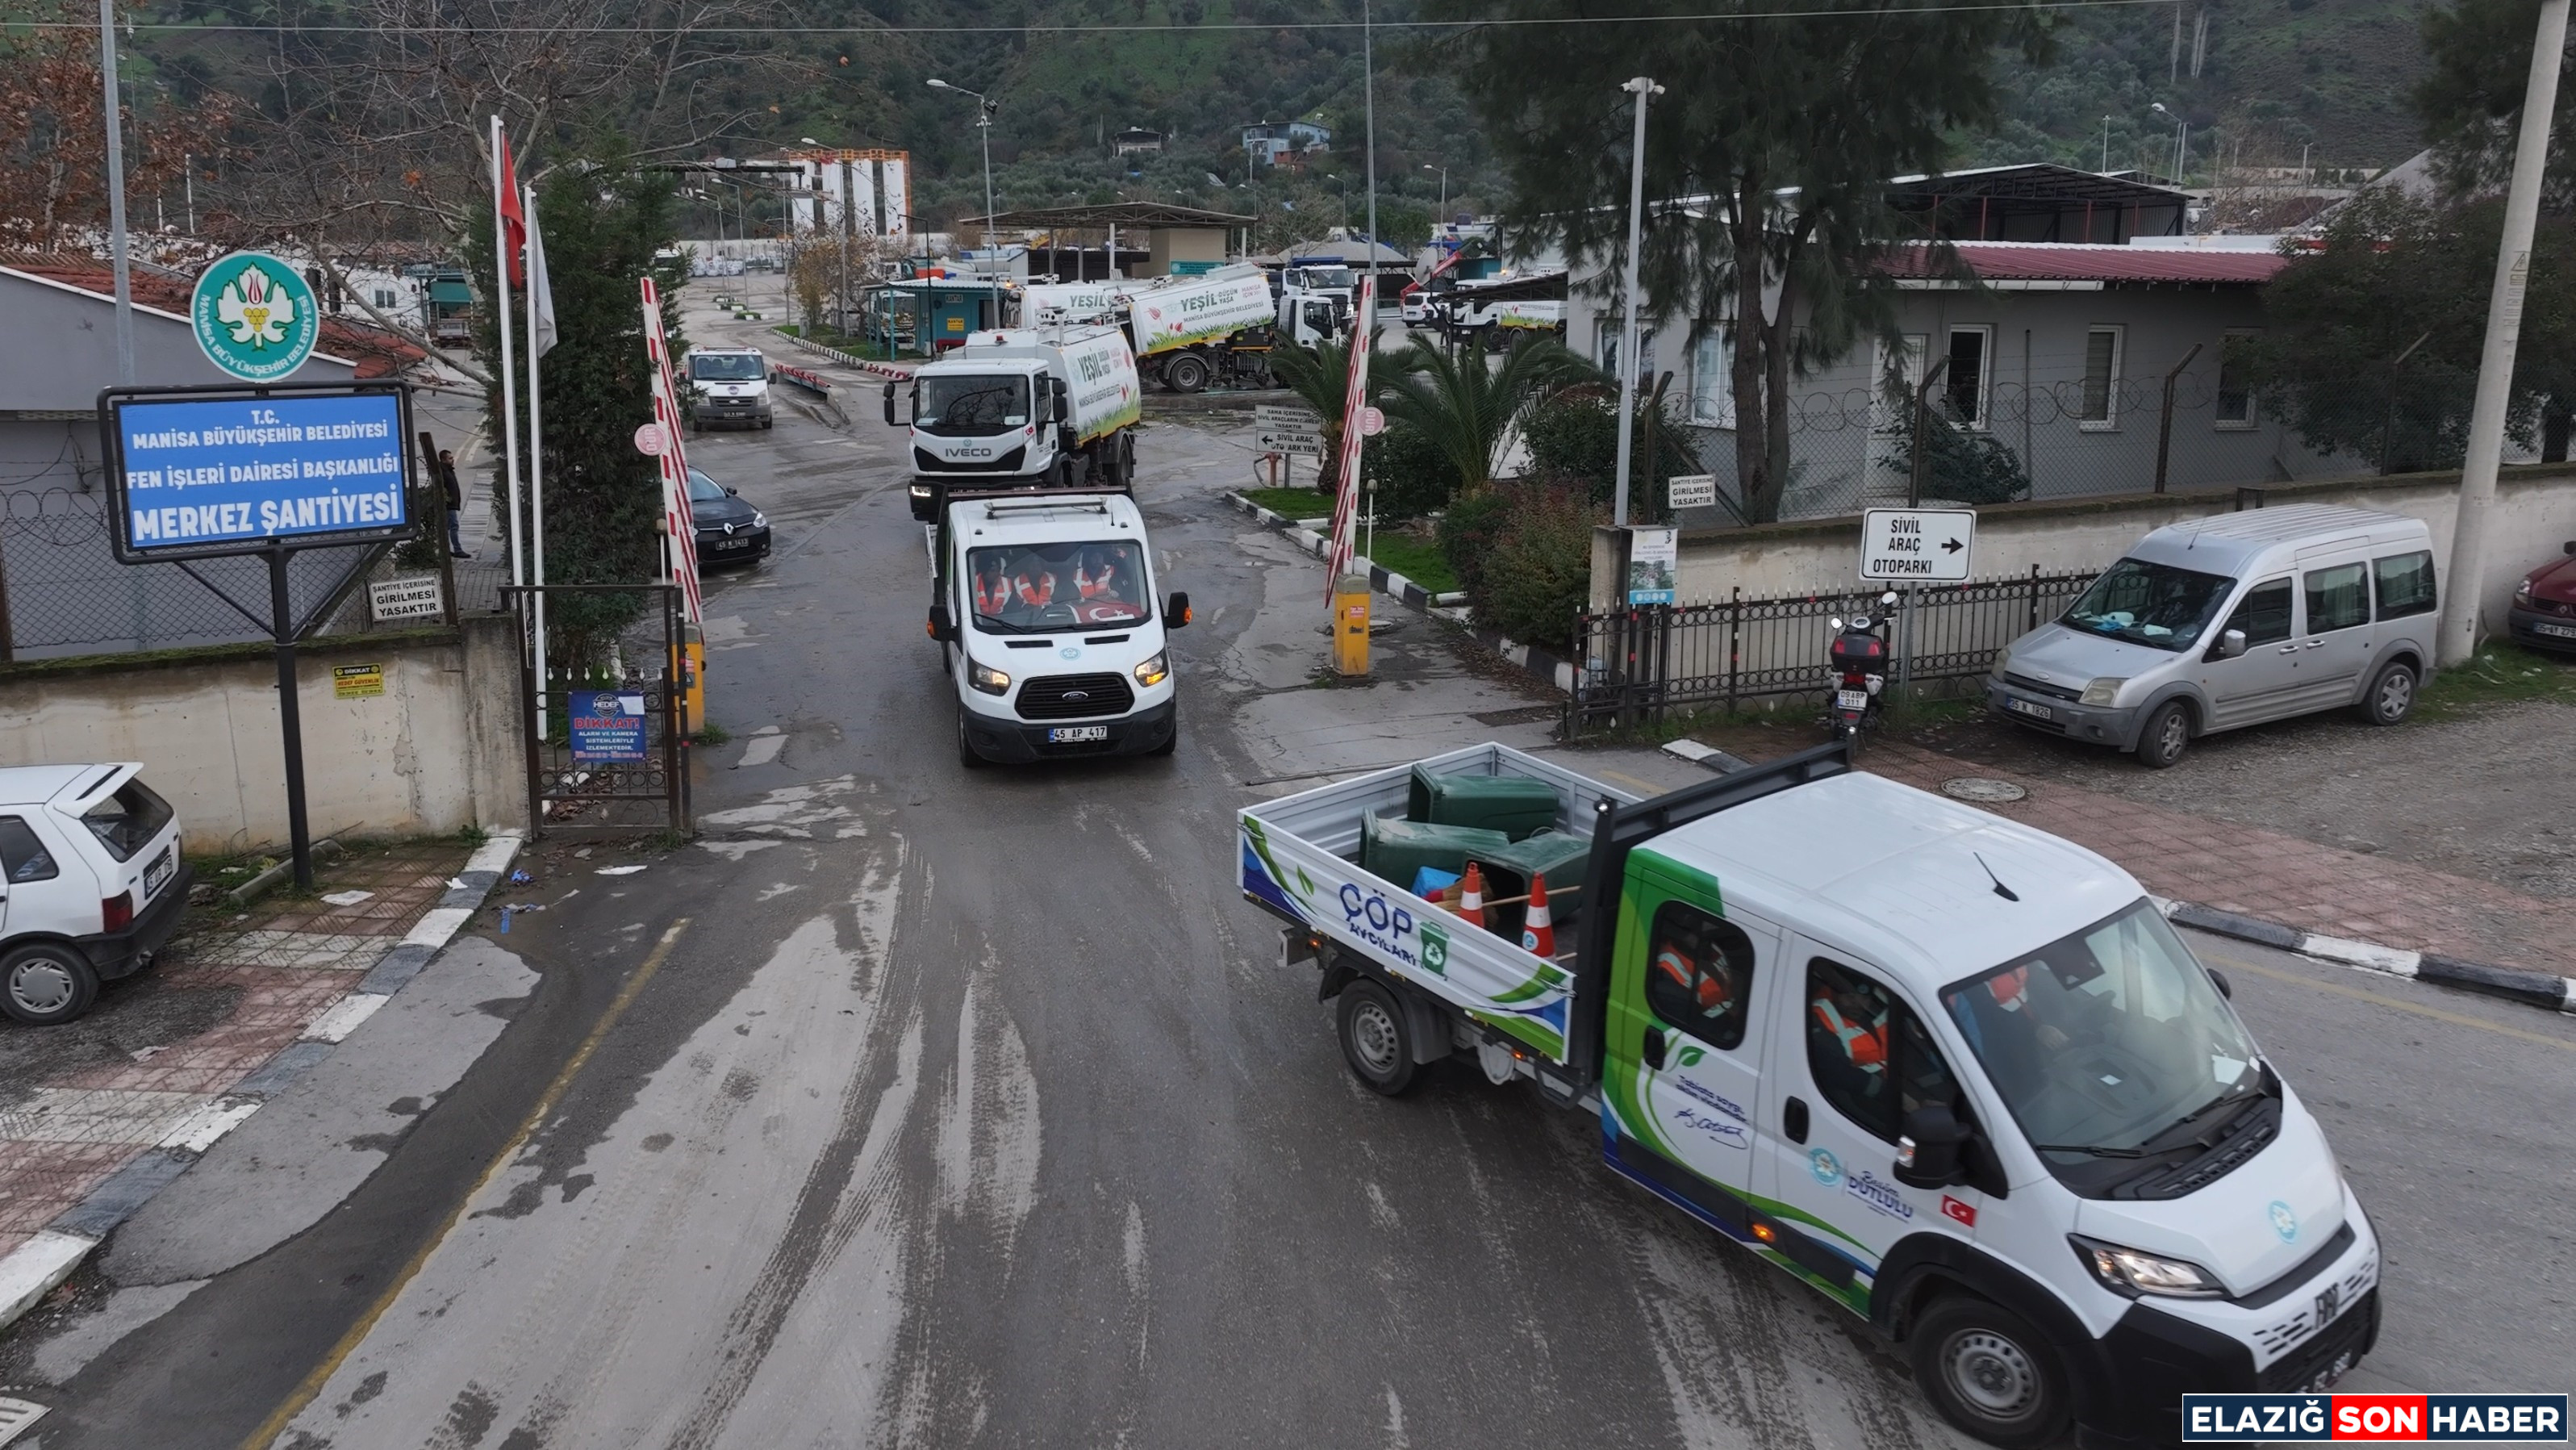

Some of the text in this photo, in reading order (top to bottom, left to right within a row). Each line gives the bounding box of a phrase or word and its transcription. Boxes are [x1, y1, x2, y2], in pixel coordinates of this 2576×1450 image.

[1070, 291, 1105, 309] YEŞİL
[1181, 290, 1217, 312] YEŞİL
[1219, 296, 1234, 305] YAŞA
[1184, 300, 1264, 323] MANİSA BÜYÜKŞEHİR BELEDİYESİ
[198, 294, 312, 377] MANİSA BÜYÜKŞEHİR BELEDİYESİ
[1077, 346, 1103, 386] YEŞİL
[251, 409, 280, 425] T.C.
[1365, 412, 1376, 432] DUR
[132, 419, 388, 449] MANİSA BÜYÜKŞEHİR BELEDİYESİ
[645, 428, 658, 451] DUR
[1277, 432, 1313, 444] SİVİL ARAÇ
[945, 448, 992, 457] IVECO
[127, 452, 399, 490] FEN İŞLERİ DAİRESİ BAŞKANLIĞI
[1672, 486, 1712, 496] GİRİLMESİ
[1672, 496, 1712, 506] YASAKTIR
[133, 483, 399, 541] MERKEZ ŞANTİYESİ
[1890, 516, 1921, 534] SİVİL
[1888, 537, 1921, 555] ARAÇ
[1873, 558, 1932, 574] OTOPARKI
[373, 579, 436, 594] ŞANTİYE İÇERİSİNE
[377, 588, 436, 605] GİRİLMESİ
[379, 602, 436, 616] YASAKTIR
[344, 666, 370, 675] DİKKAT
[574, 716, 640, 729] DİKKAT!
[1054, 727, 1105, 738] 45 AP 417
[1339, 883, 1413, 939] ÇÖP
[1350, 922, 1417, 967] AVCILARI
[1848, 1176, 1914, 1218] DUTLULU
